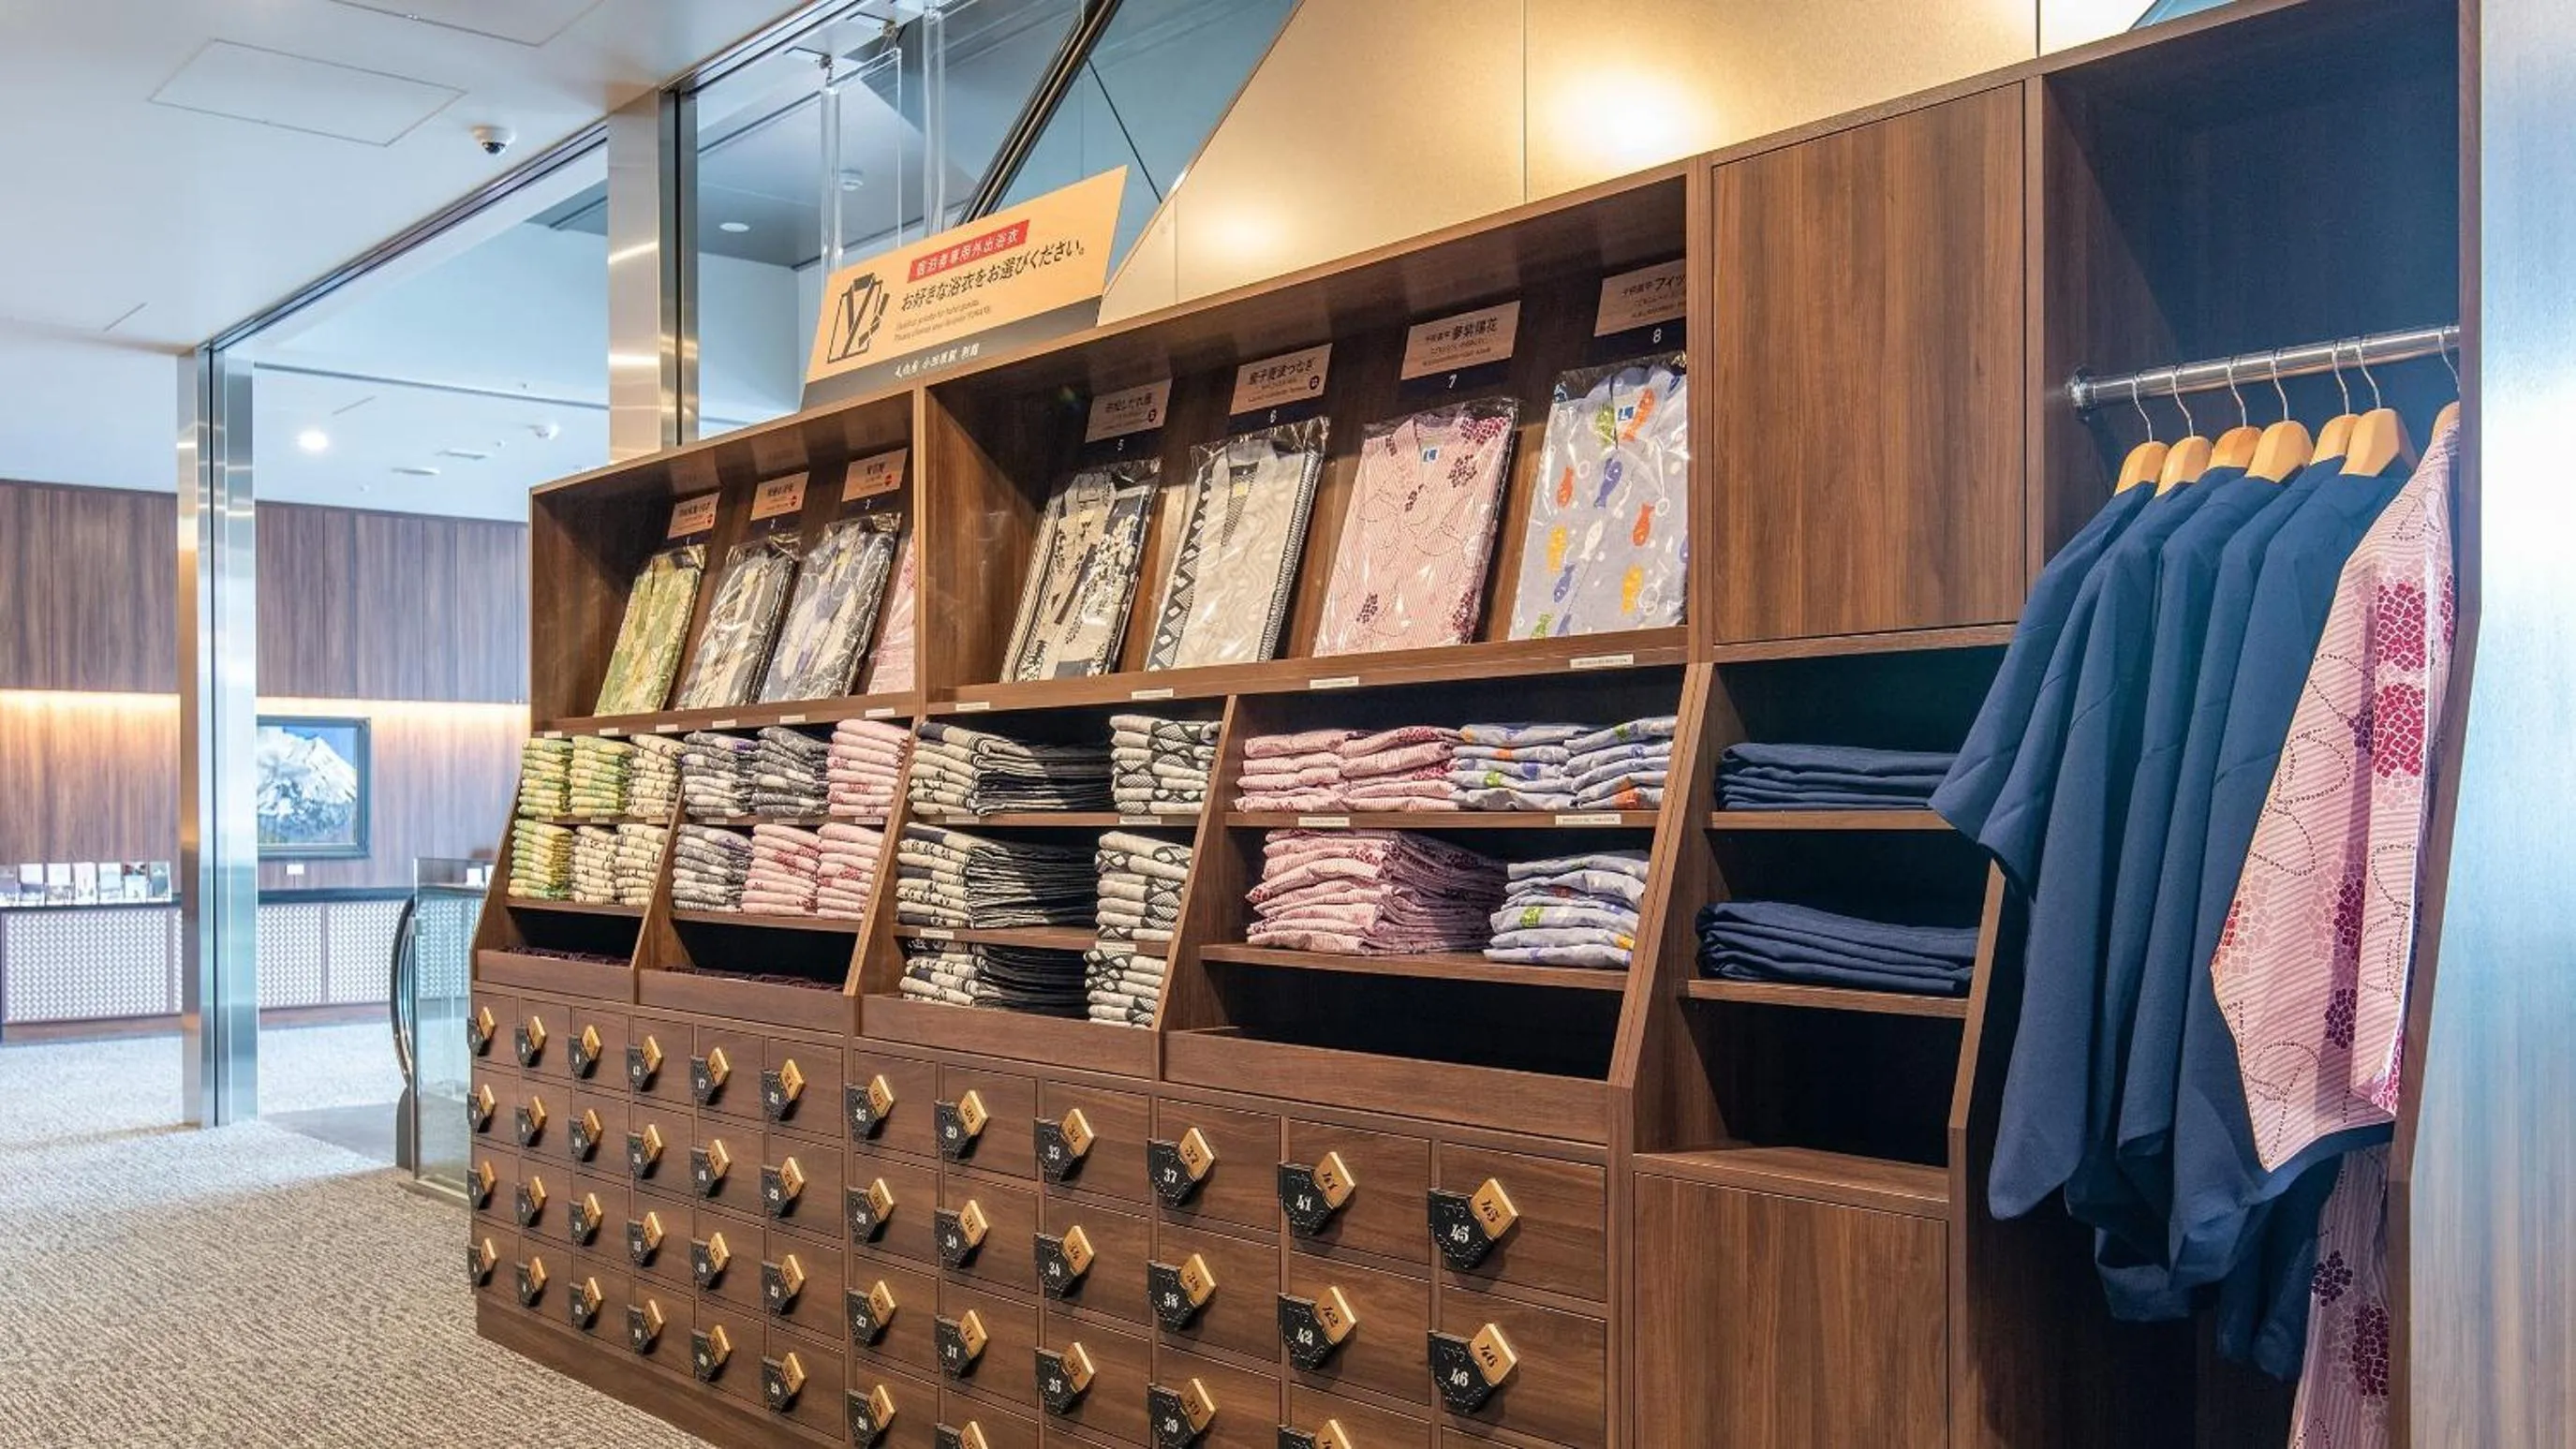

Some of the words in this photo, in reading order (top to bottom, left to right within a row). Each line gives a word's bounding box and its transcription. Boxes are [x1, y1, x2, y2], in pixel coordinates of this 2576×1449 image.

[901, 239, 1085, 313] お好きな浴衣をお選びください。
[1652, 328, 1662, 344] 8
[1448, 376, 1458, 390] 7
[1269, 410, 1277, 423] 6
[1118, 438, 1125, 451] 5
[1163, 1167, 1177, 1183] 37
[1322, 1171, 1338, 1190] 41
[1295, 1194, 1312, 1212] 41
[1481, 1199, 1500, 1222] 45
[1450, 1222, 1470, 1244] 45
[1048, 1261, 1060, 1277] 34
[1163, 1293, 1178, 1309] 38
[1322, 1306, 1339, 1328] 42
[1295, 1327, 1313, 1346] 42
[1480, 1344, 1498, 1367] 46
[1450, 1368, 1469, 1386] 46
[1048, 1378, 1061, 1394] 35
[1163, 1417, 1178, 1433] 39
